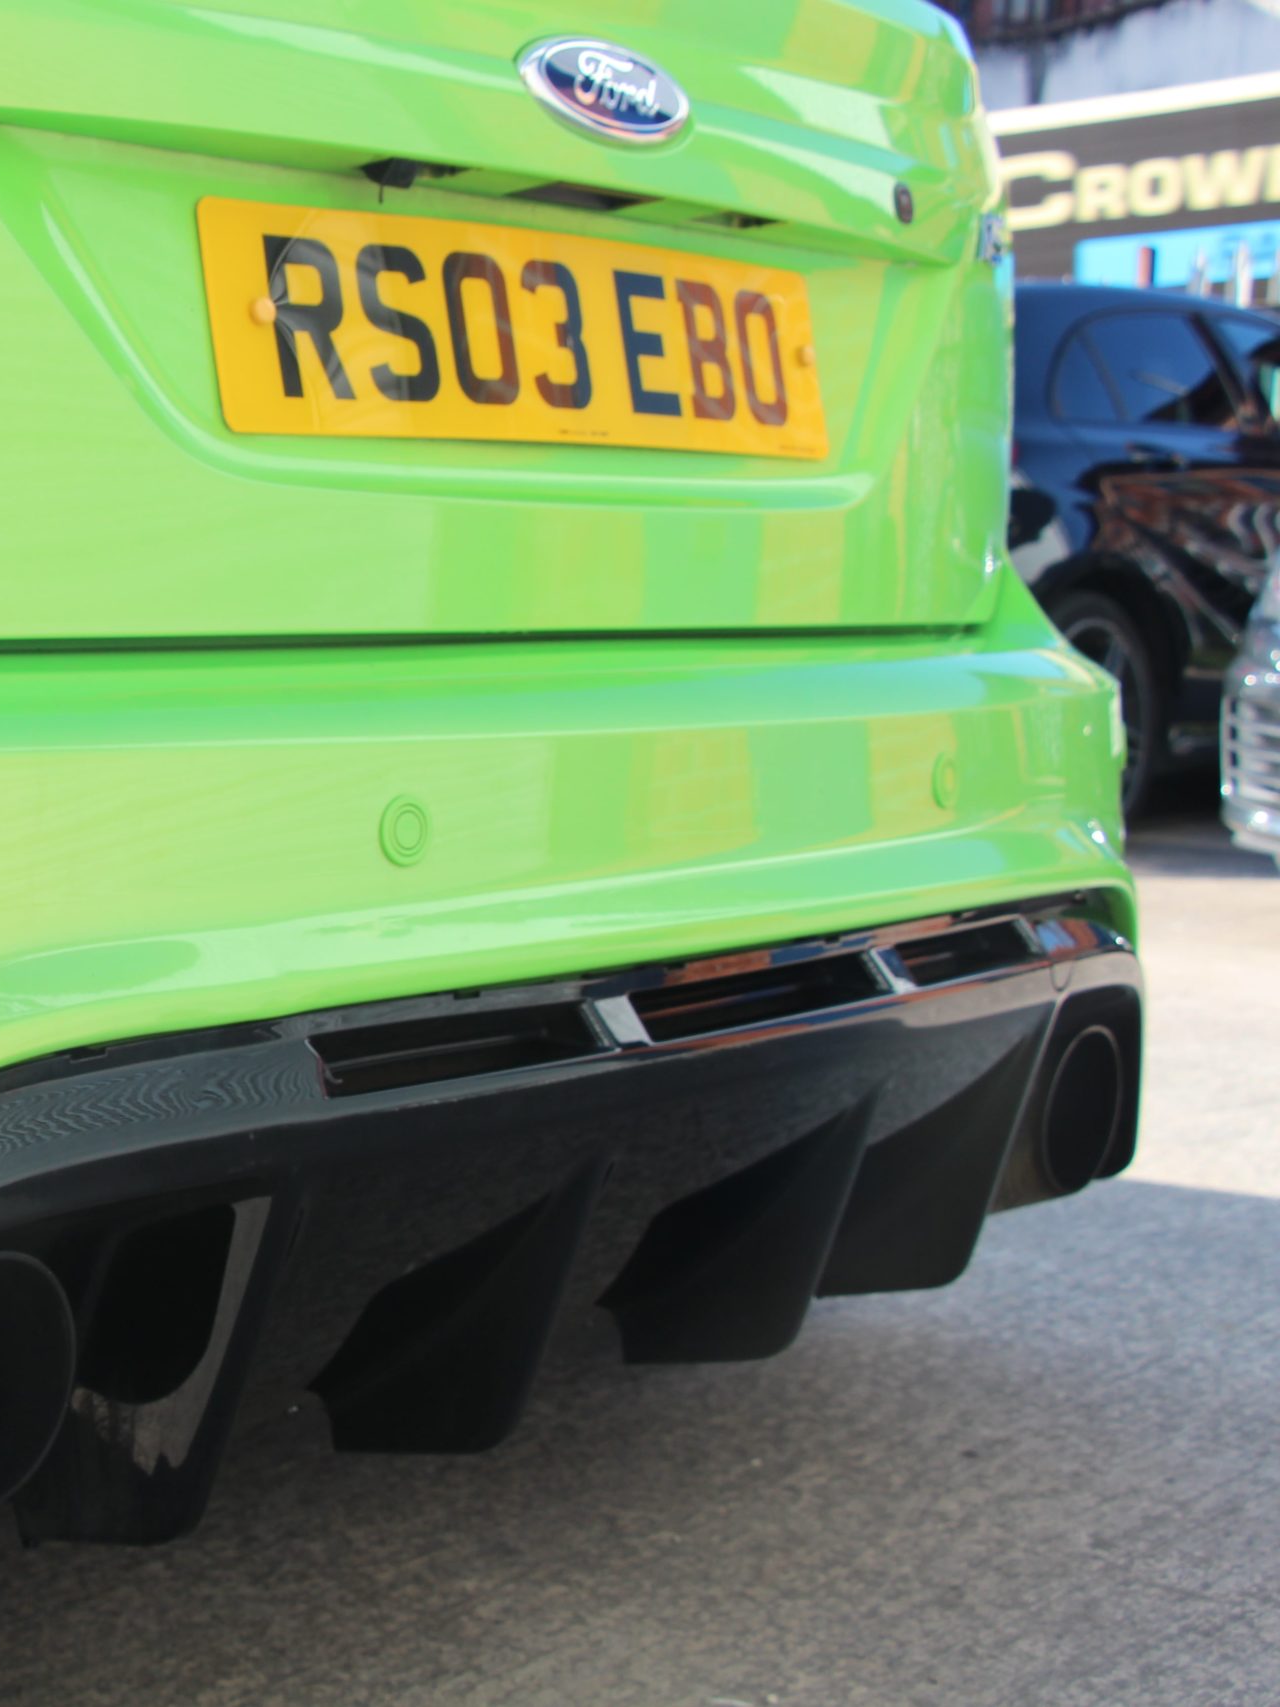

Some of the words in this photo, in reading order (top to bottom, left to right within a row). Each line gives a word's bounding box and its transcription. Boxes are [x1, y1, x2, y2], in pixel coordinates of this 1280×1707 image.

[574, 50, 661, 118] Ford
[994, 143, 1280, 232] CROW
[261, 233, 593, 410] RS03
[612, 268, 789, 427] EBO
